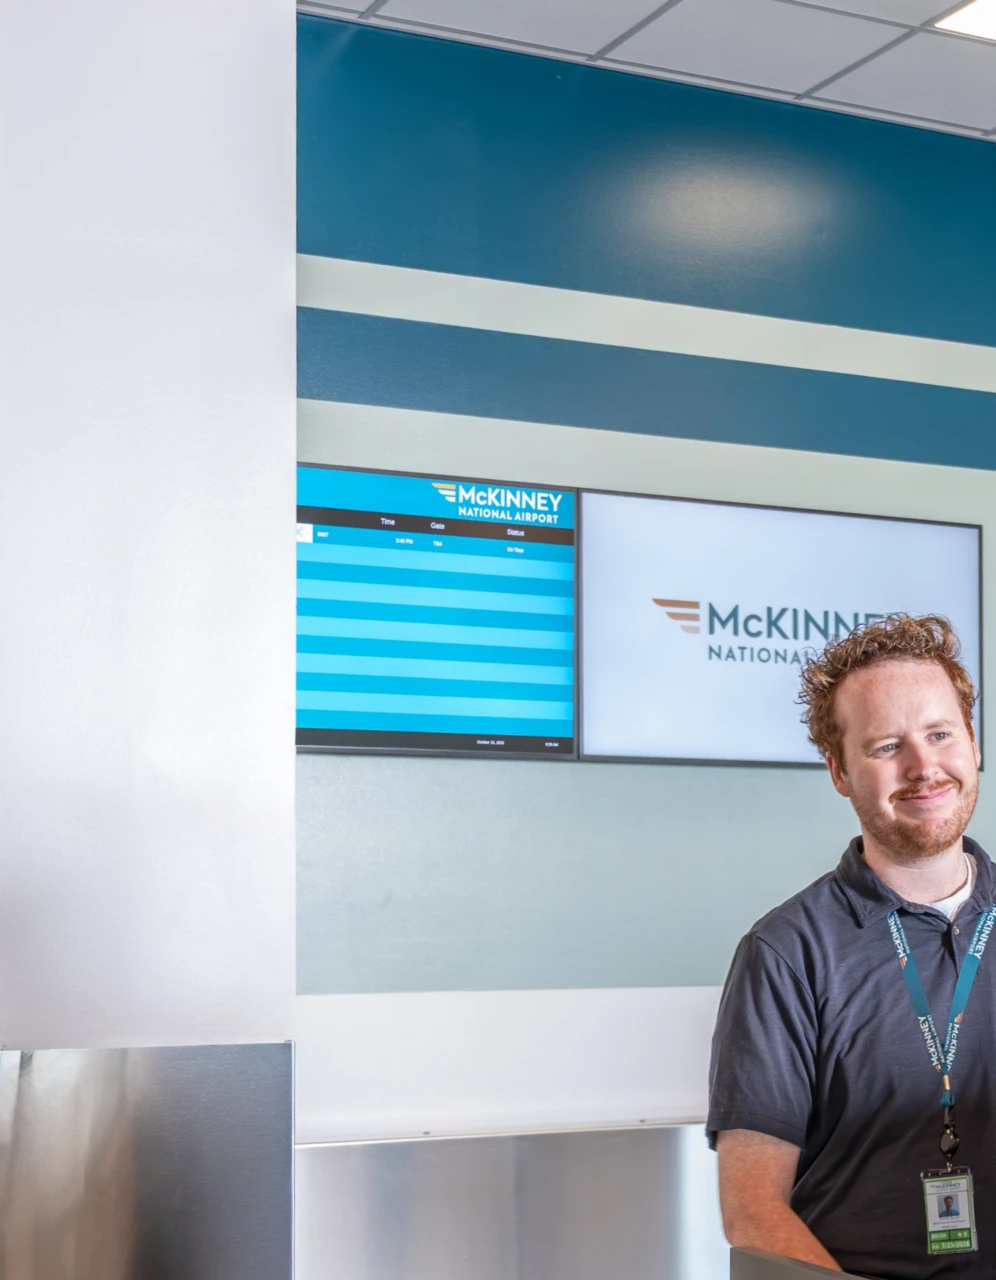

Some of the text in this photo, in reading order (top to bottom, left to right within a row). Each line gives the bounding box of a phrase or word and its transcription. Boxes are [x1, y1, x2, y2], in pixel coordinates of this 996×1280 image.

[458, 485, 563, 512] McKINNEY
[381, 517, 396, 526] Time
[458, 506, 559, 525] NATIONAL AIRPORT
[430, 522, 445, 530] Gate
[507, 529, 525, 537] Status
[917, 1015, 939, 1067] McKINNEY
